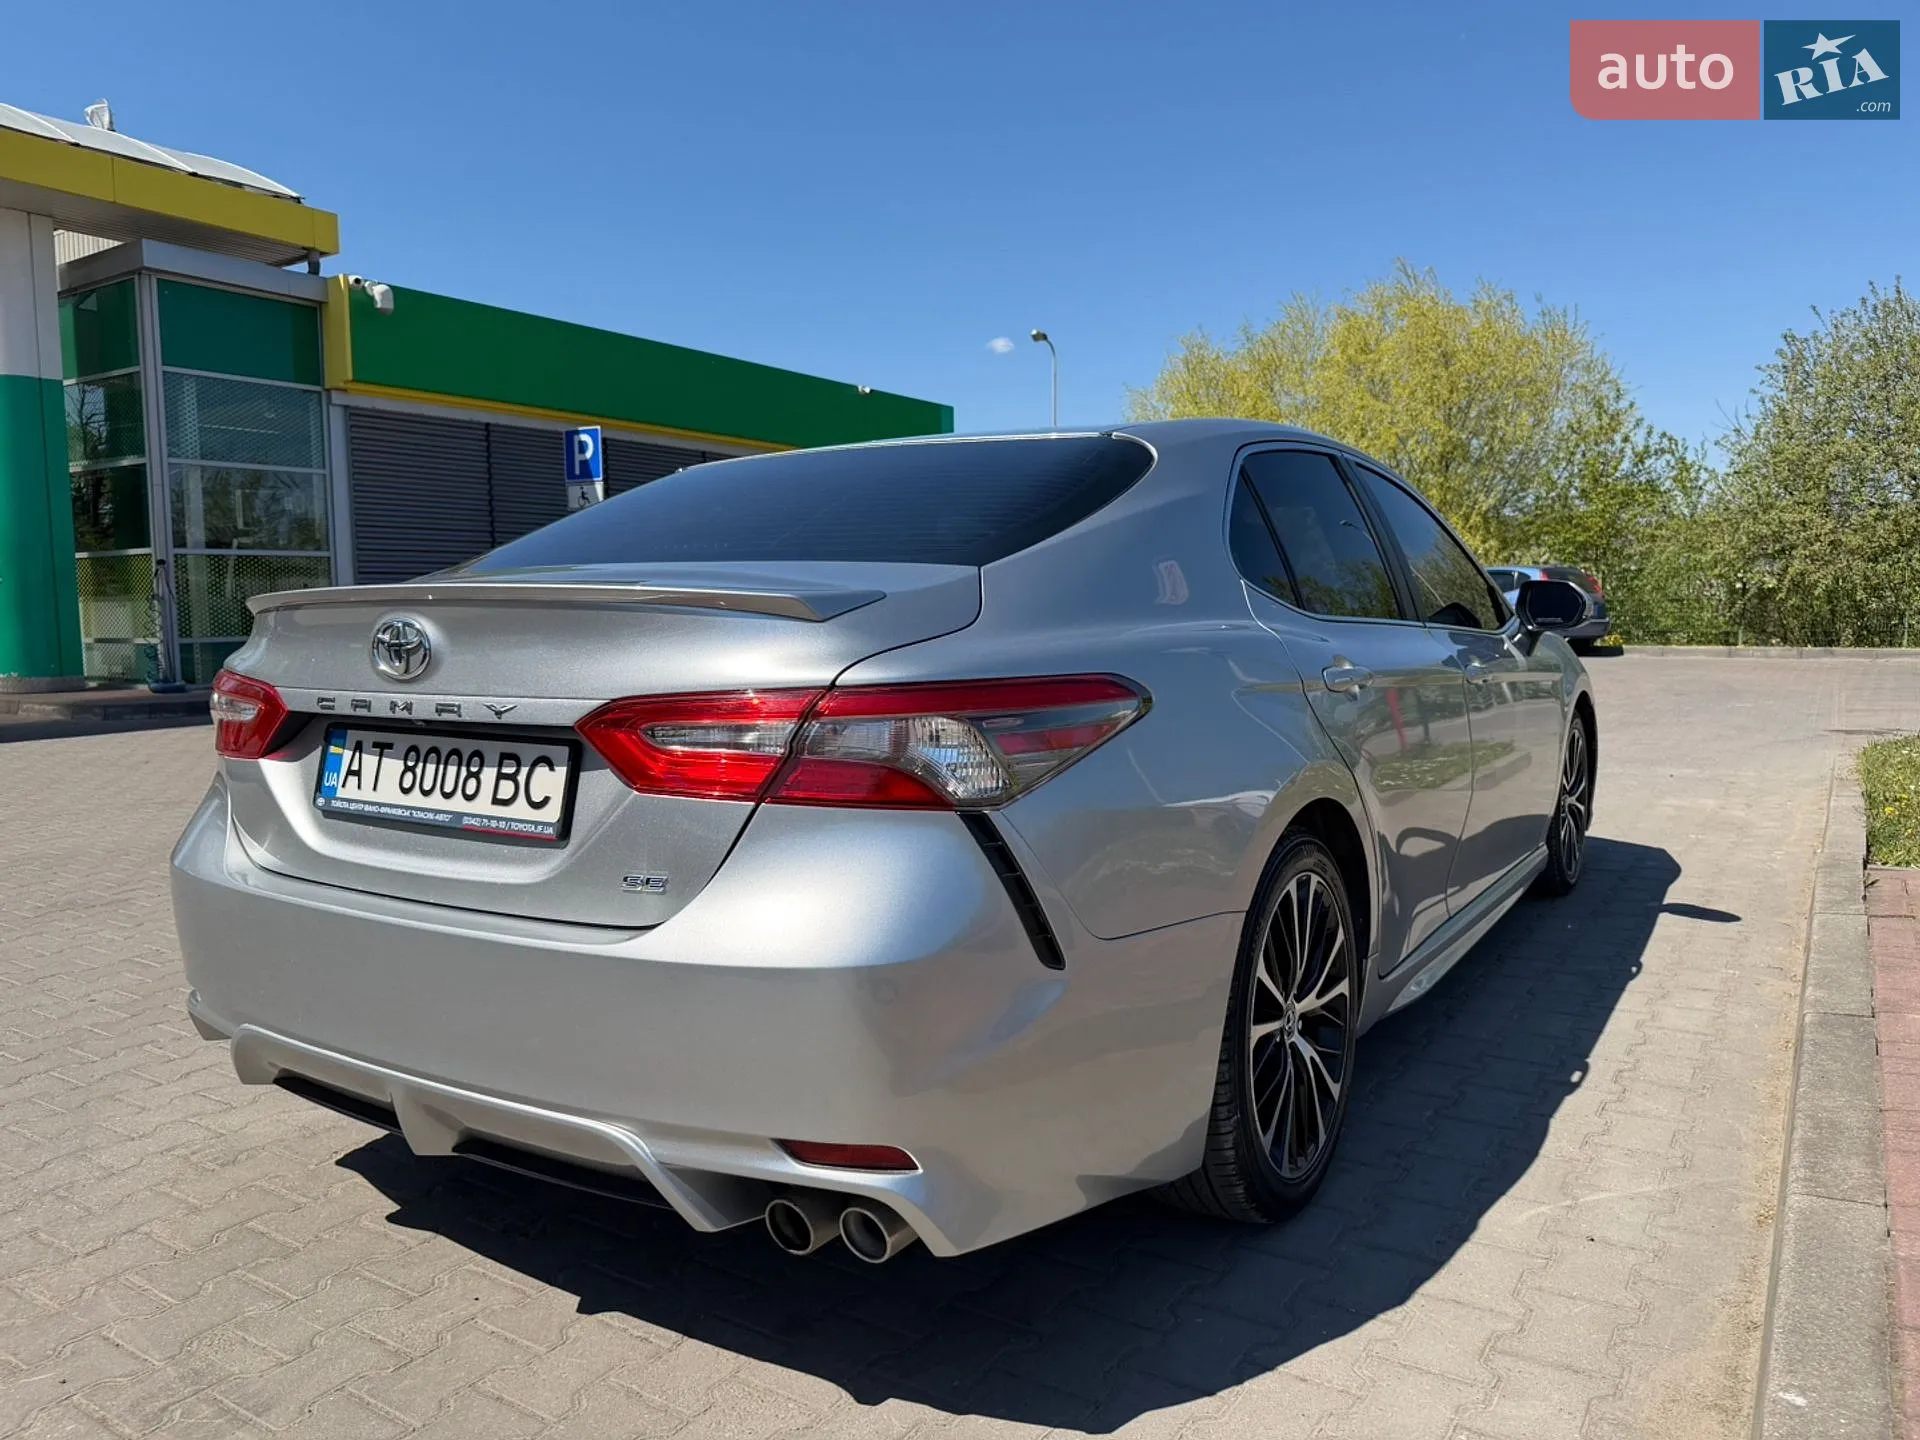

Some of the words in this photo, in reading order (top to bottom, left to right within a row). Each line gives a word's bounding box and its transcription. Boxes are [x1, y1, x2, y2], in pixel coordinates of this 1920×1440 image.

[573, 433, 594, 475] P
[316, 696, 519, 720] CAMRY
[324, 771, 338, 788] UA
[341, 739, 394, 792] AT
[399, 744, 486, 802] 8008
[491, 751, 556, 811] BC
[621, 874, 669, 893] SE
